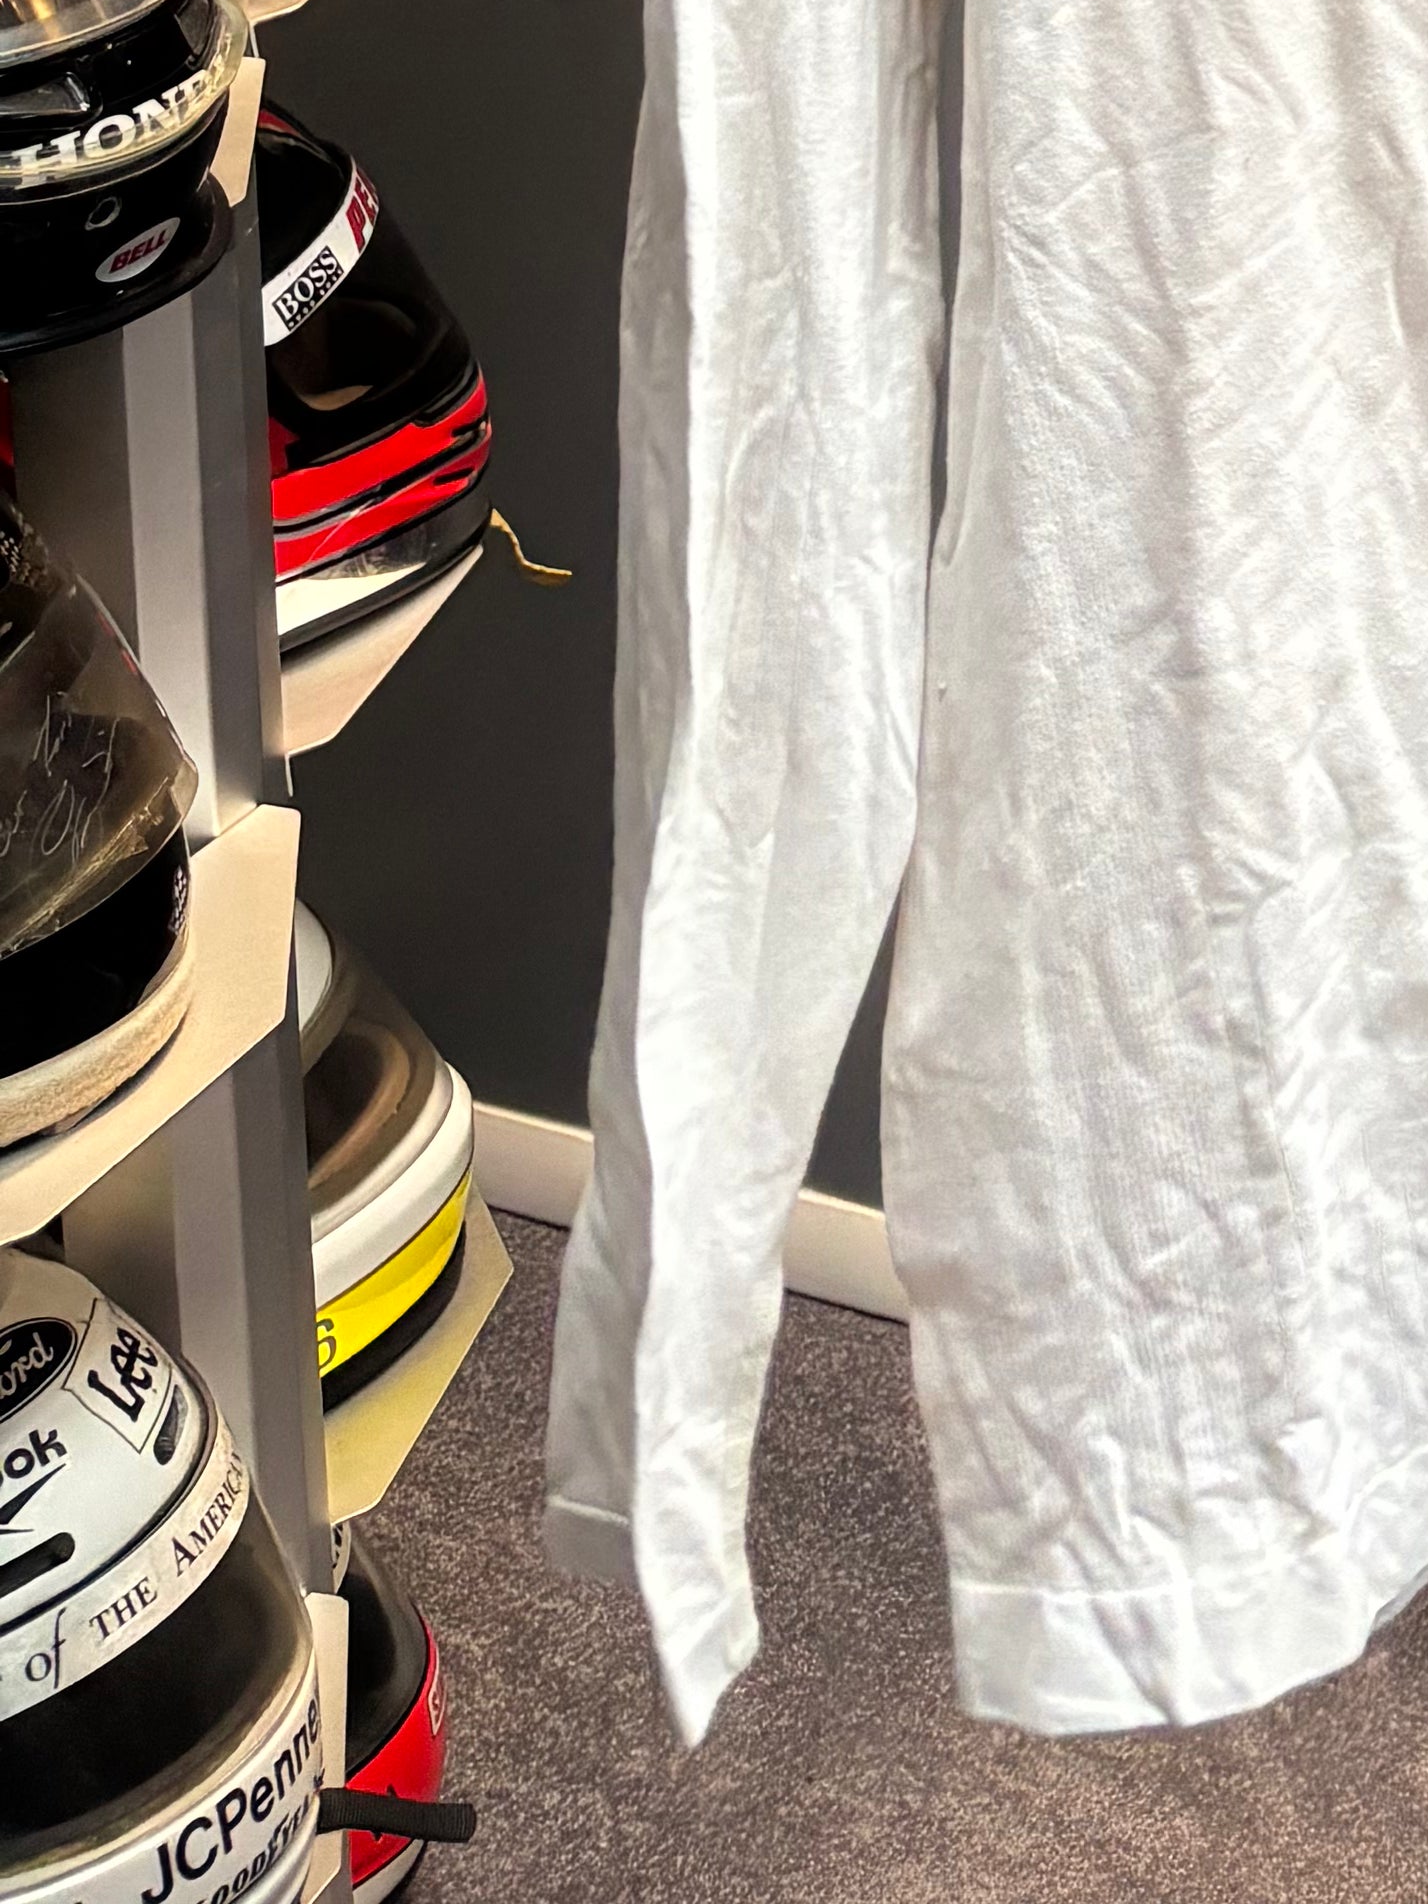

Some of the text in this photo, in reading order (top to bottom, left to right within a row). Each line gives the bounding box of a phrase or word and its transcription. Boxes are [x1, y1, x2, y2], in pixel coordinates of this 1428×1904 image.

[109, 230, 166, 274] BELL
[275, 250, 338, 321] BOSS
[87, 1327, 158, 1423] Lee
[0, 1429, 68, 1485] ok
[25, 1607, 67, 1690] of
[89, 1576, 158, 1642] THE
